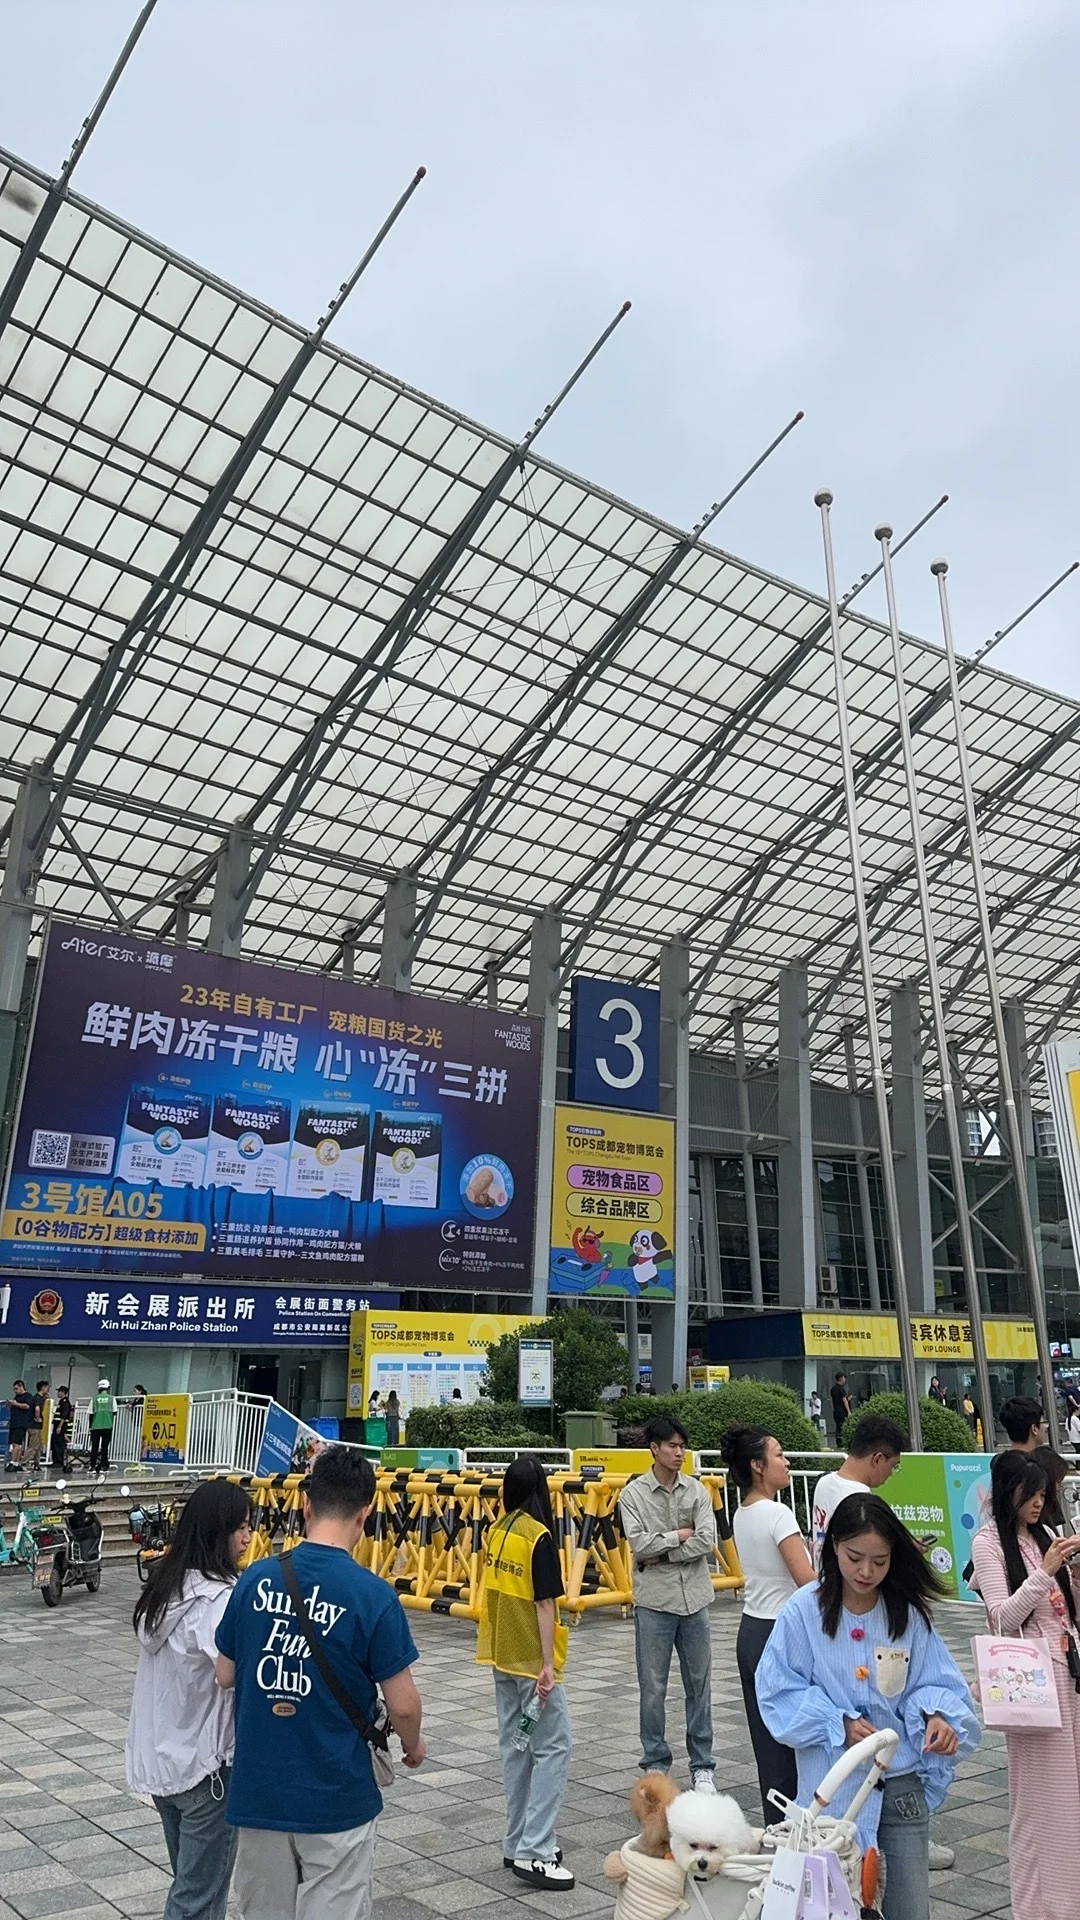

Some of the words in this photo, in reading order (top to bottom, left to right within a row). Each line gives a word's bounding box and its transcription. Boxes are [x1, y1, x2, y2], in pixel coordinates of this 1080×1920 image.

[180, 984, 317, 1024] 23年自有工厂
[328, 1010, 442, 1049] 宠粮国货之光
[81, 1001, 300, 1074] 鲜肉冻干粮
[495, 1029, 531, 1043] FANTASTIC
[596, 998, 644, 1089] 3
[505, 1039, 531, 1051] WOODS
[141, 1101, 200, 1119] FANTASTIC
[149, 1111, 191, 1125] WOODS
[225, 1108, 280, 1124] FANTASTIC
[232, 1117, 272, 1130] WOODS
[307, 1118, 358, 1129] FANTASTIC
[313, 1126, 349, 1136] WOODS
[382, 1127, 431, 1138] FANTASTIC
[389, 1135, 423, 1145] WOODS
[566, 1136, 664, 1158] TOPS成都宠物博览会
[581, 1169, 650, 1191] 宠物食品区
[21, 1182, 164, 1219] 3号馆A05
[580, 1196, 650, 1218] 综合品牌区
[85, 1291, 256, 1320] 新会展派出所
[275, 1296, 370, 1311] 会展街面警务站
[101, 1320, 120, 1330] Xin
[120, 1321, 139, 1331] Hui
[140, 1321, 168, 1331] Zhan
[169, 1322, 201, 1332] Police
[202, 1322, 238, 1333] Station
[812, 1330, 872, 1339] TOPS成都宠物博览会
[910, 1324, 972, 1342] 贵宾休息室
[371, 1330, 455, 1342] TOPS成都宠物博览会
[160, 1423, 176, 1440] 入口
[262, 1618, 312, 1659] Fun
[256, 1655, 312, 1697] Club
